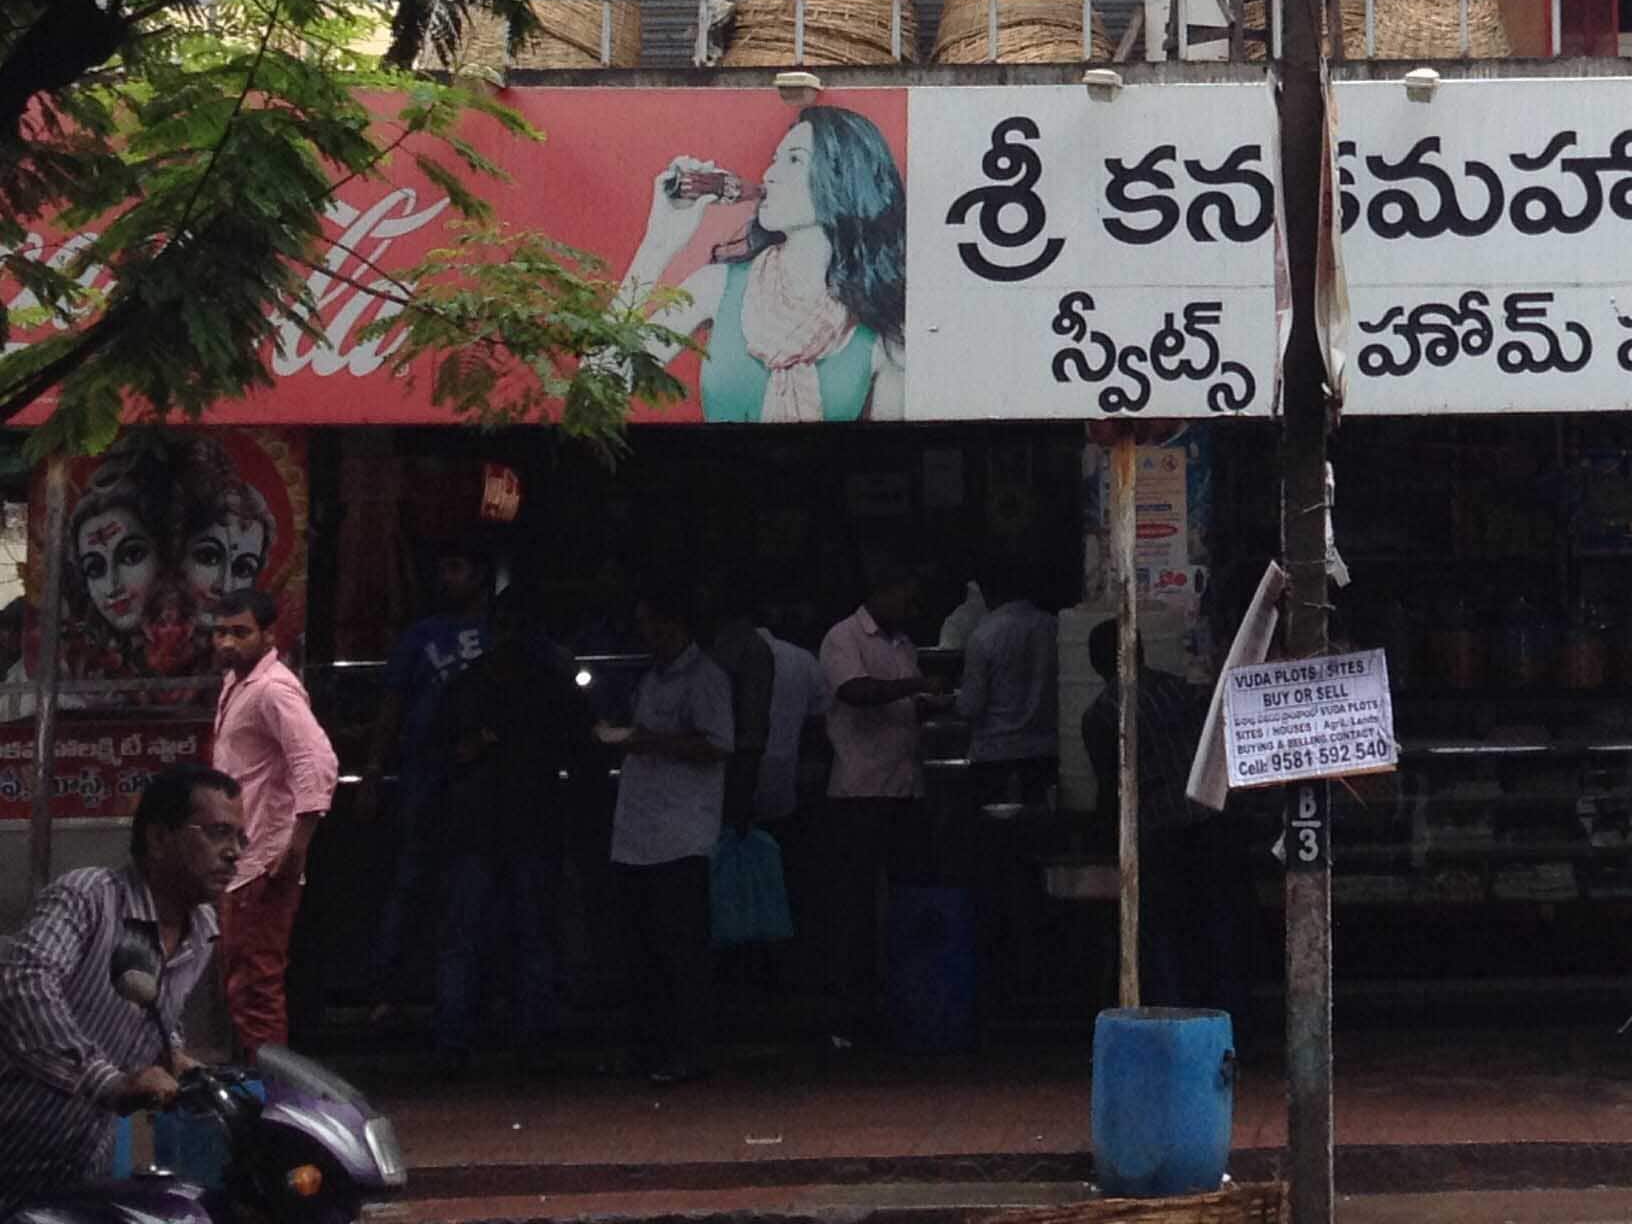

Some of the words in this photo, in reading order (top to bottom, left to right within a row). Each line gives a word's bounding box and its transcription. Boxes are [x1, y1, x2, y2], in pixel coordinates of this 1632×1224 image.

[945, 116, 1065, 282] శ్రీ
[1052, 291, 1255, 413] స్వీట్స్
[1358, 290, 1592, 378] హోమ్
[1235, 674, 1272, 688] VUDA
[1275, 668, 1317, 683] PLOTS
[1327, 660, 1365, 677] SITES
[1263, 692, 1289, 707] BUY
[1294, 689, 1313, 704] OR
[1317, 683, 1349, 700] SELL
[1348, 699, 1379, 711] PLOTS
[1235, 727, 1263, 741] SITES
[1237, 739, 1273, 754] BUYING
[1271, 751, 1313, 771] 9581
[1319, 745, 1351, 764] 592
[1355, 739, 1388, 759] 540
[1298, 829, 1319, 862] 3
